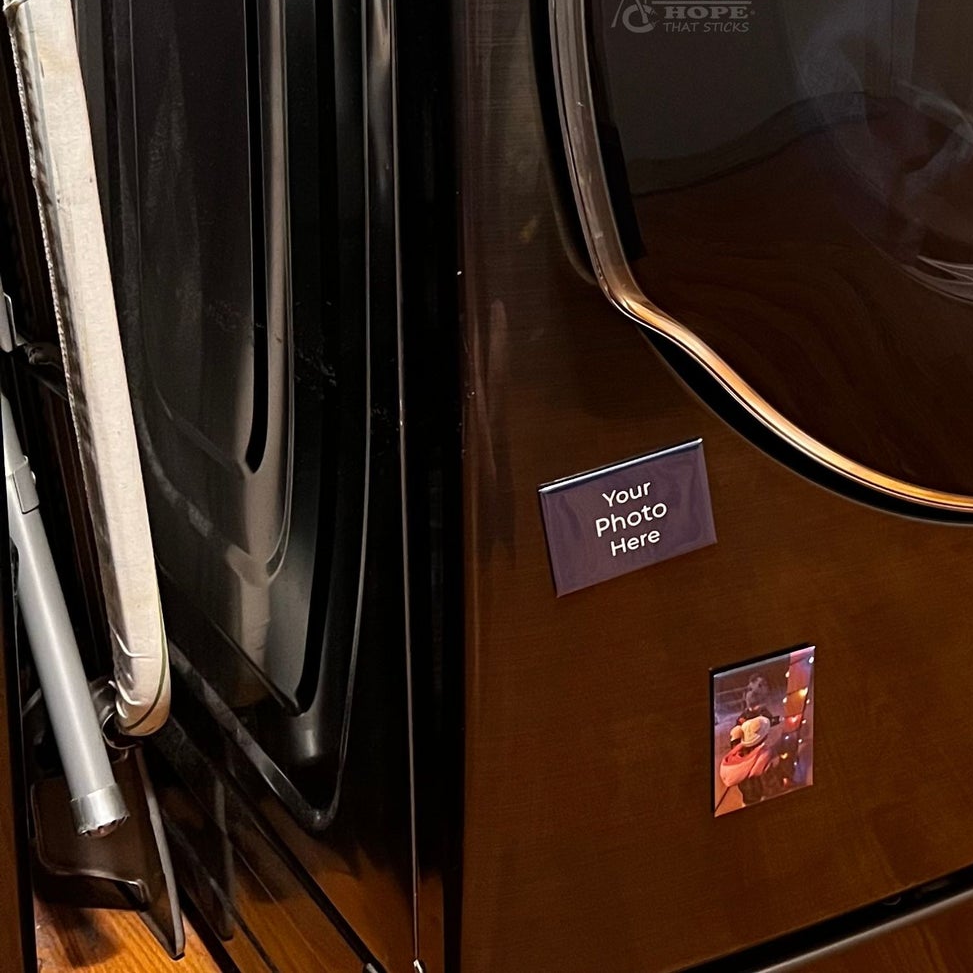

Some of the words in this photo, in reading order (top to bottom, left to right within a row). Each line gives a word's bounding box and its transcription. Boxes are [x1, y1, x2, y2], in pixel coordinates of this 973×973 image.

[602, 481, 651, 507] Your
[595, 503, 667, 537] Photo
[610, 530, 660, 557] Here
